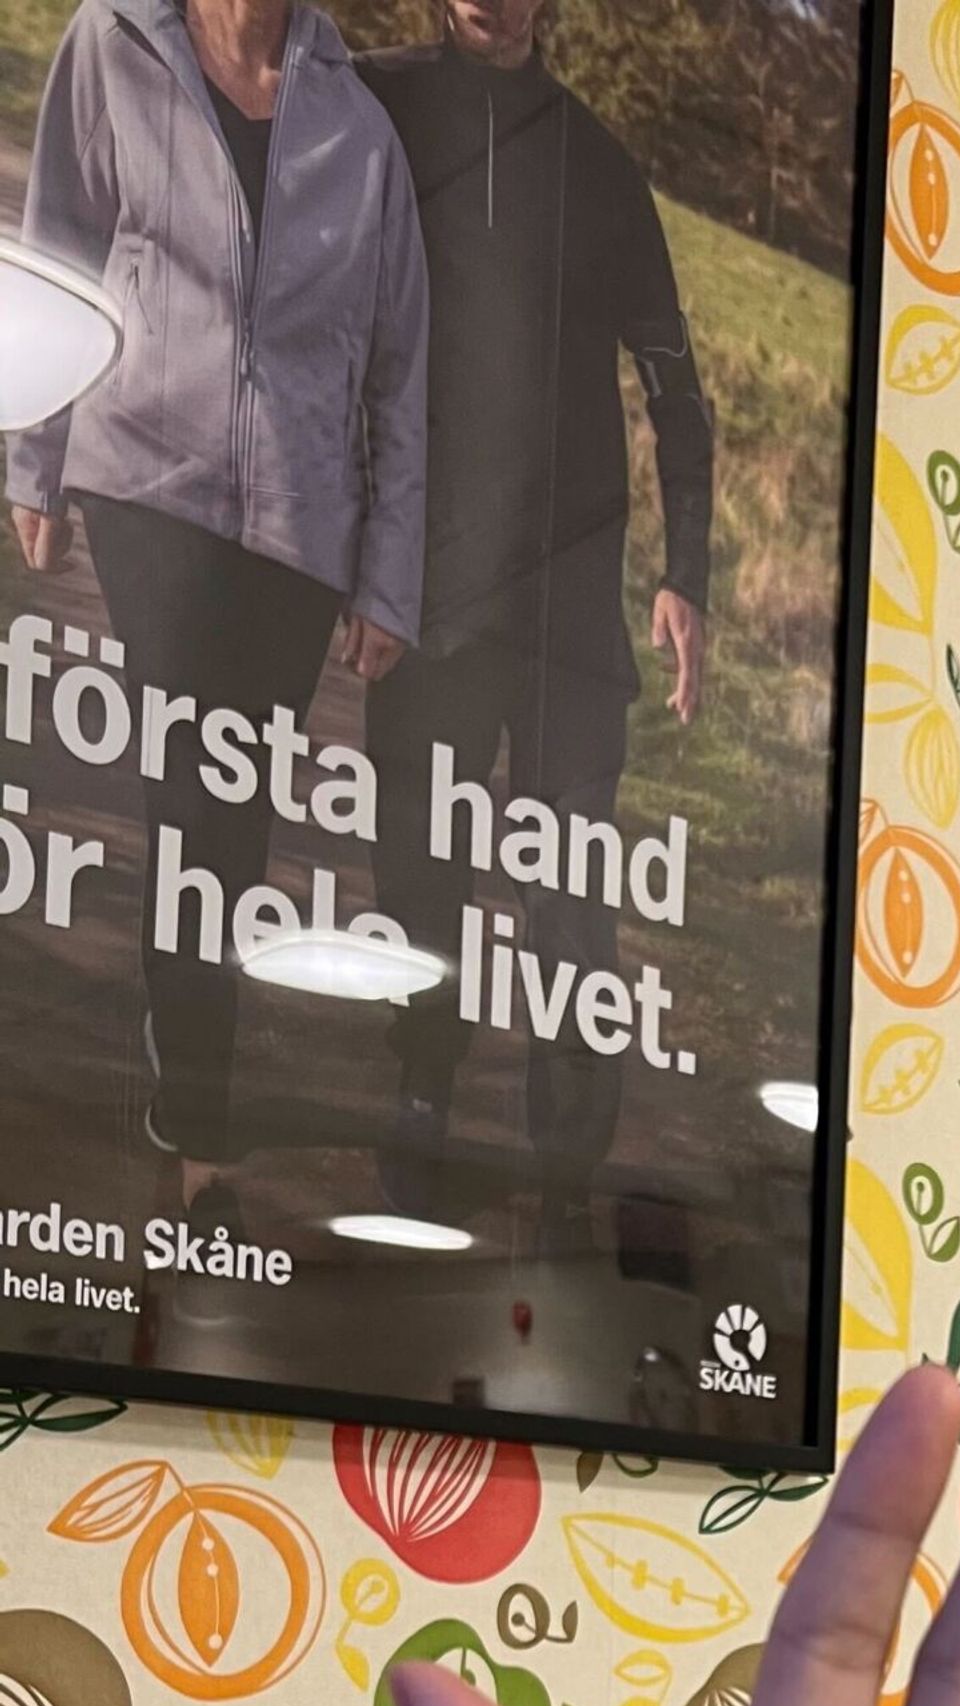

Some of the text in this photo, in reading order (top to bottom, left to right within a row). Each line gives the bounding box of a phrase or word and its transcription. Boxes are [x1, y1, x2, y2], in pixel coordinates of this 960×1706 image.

[0, 614, 689, 927] första hand
[459, 904, 697, 1075] livet.
[0, 1202, 293, 1286] rden Skåne
[3, 1267, 141, 1314] hela livet.
